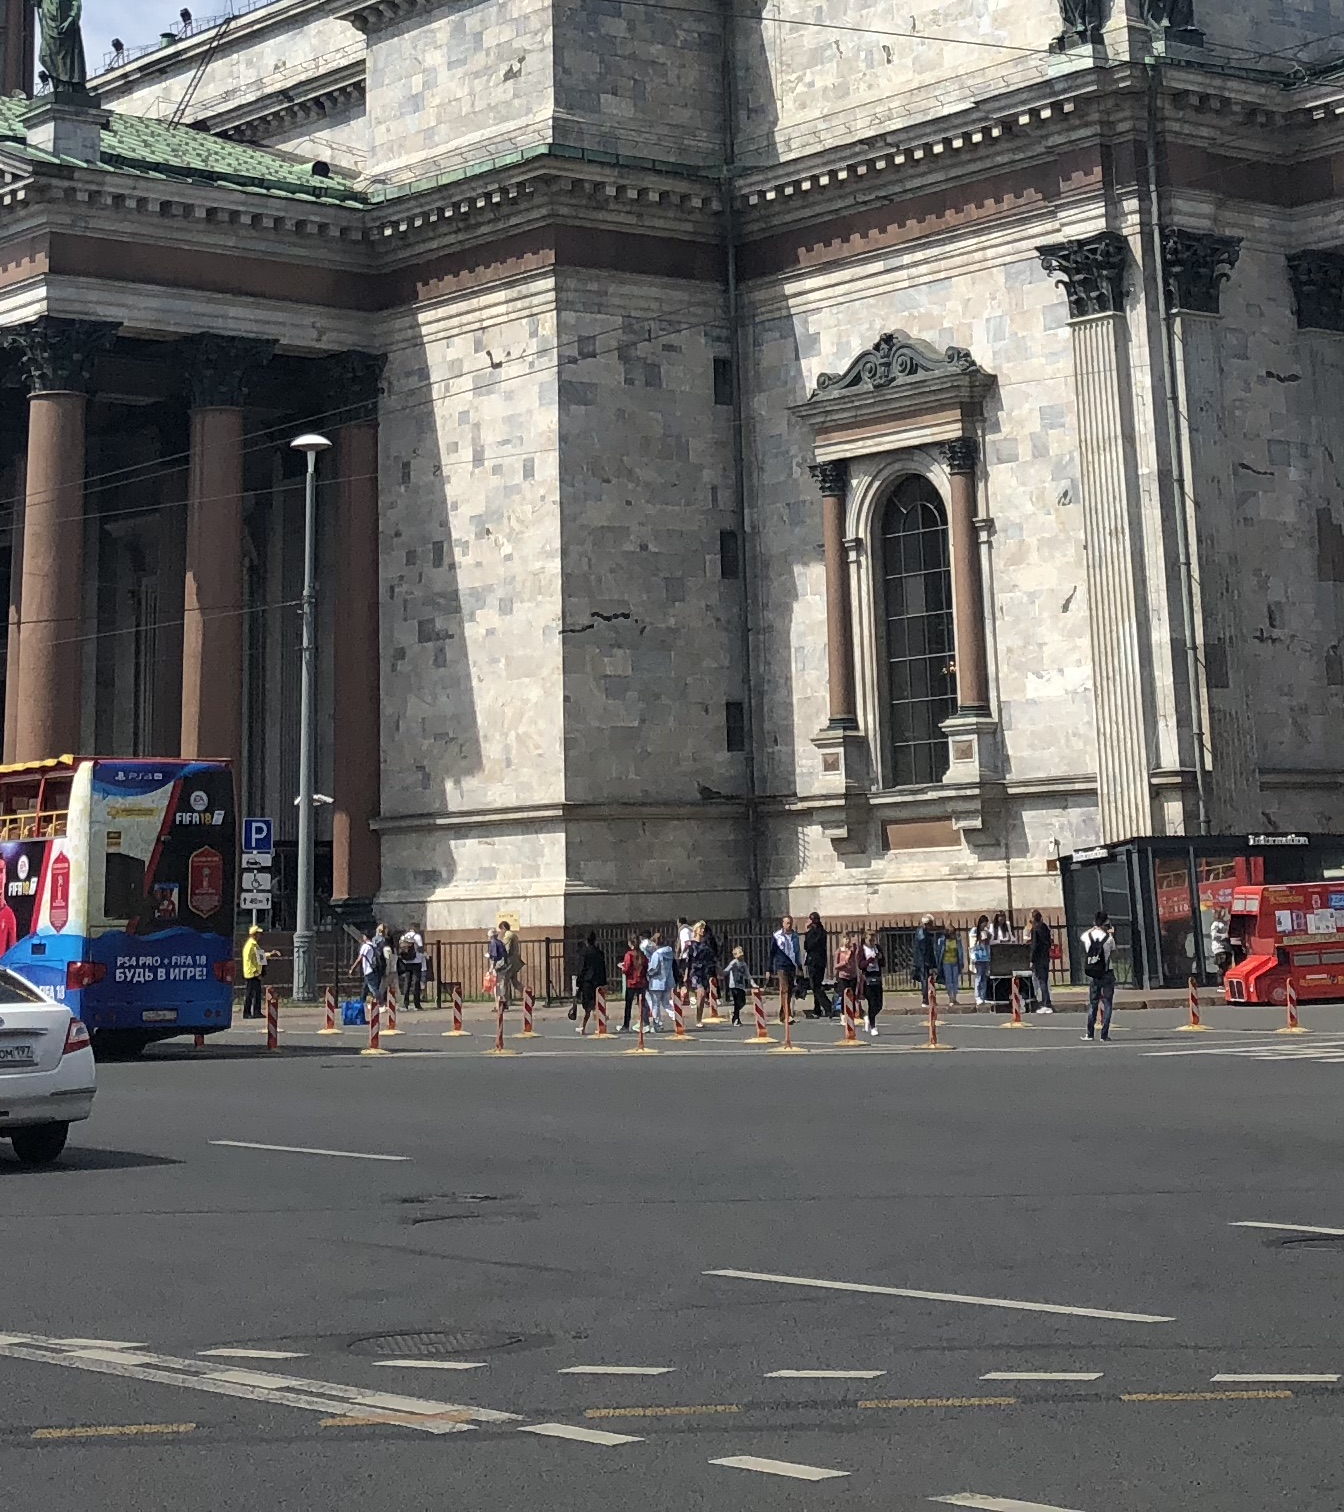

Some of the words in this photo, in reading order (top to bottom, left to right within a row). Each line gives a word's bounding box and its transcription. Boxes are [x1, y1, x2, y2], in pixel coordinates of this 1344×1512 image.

[251, 821, 268, 848] P
[116, 956, 136, 967] PS4
[139, 956, 161, 967] PRO
[171, 955, 193, 966] FIFA
[195, 954, 207, 965] 18
[115, 969, 154, 984] БУДЬ
[157, 969, 166, 981] В
[169, 967, 207, 981] ИГРЕ!
